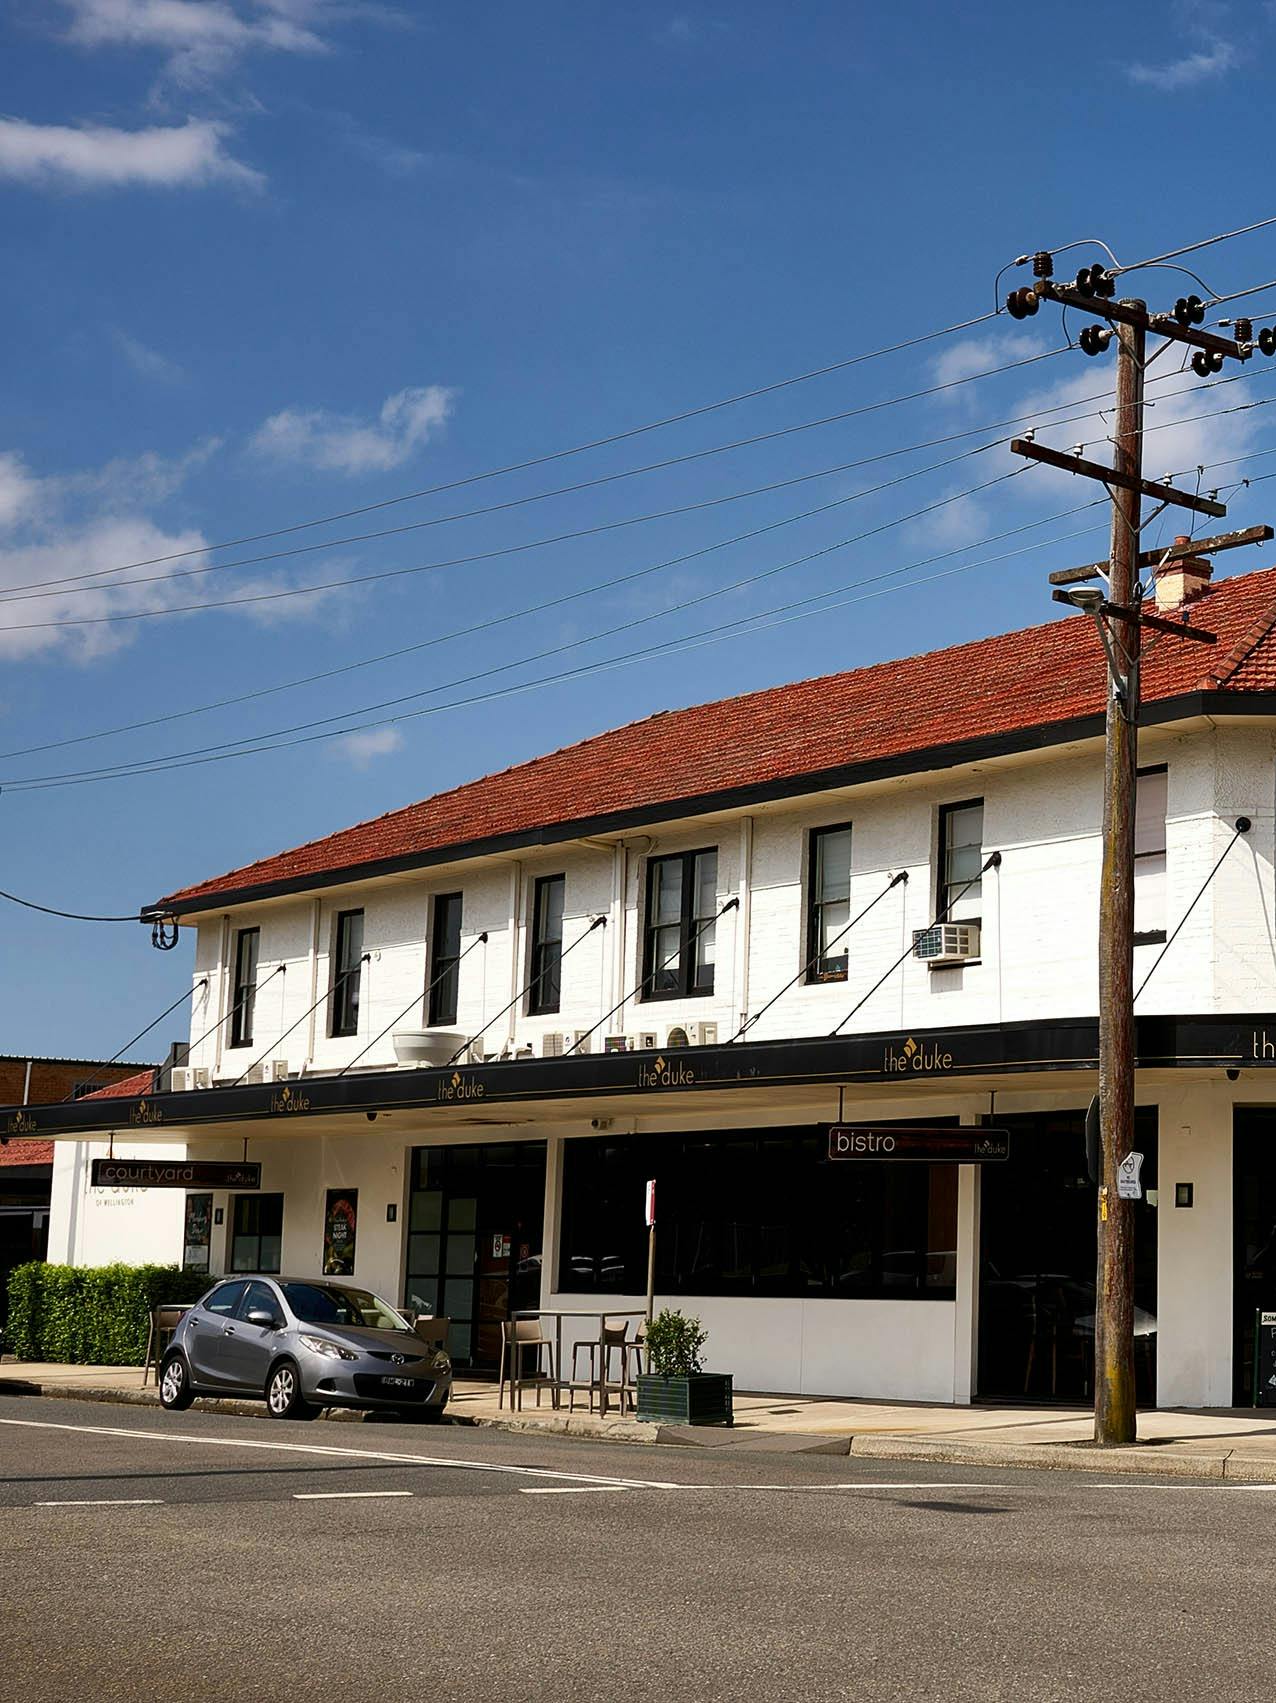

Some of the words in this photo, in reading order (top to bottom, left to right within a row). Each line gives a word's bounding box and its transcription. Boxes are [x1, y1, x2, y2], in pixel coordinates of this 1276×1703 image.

[884, 1047, 907, 1072] the
[912, 1043, 953, 1071] duke
[638, 1063, 658, 1087] the
[661, 1060, 695, 1086] duke
[437, 1080, 454, 1100] the
[456, 1075, 484, 1099] duke
[271, 1093, 285, 1112] the
[286, 1090, 310, 1111] duke
[129, 1105, 141, 1124] the
[142, 1103, 163, 1123] duke
[837, 1131, 896, 1152] bistro
[974, 1144, 985, 1154] the
[987, 1143, 1006, 1154] duke
[105, 1166, 194, 1182] courtyard
